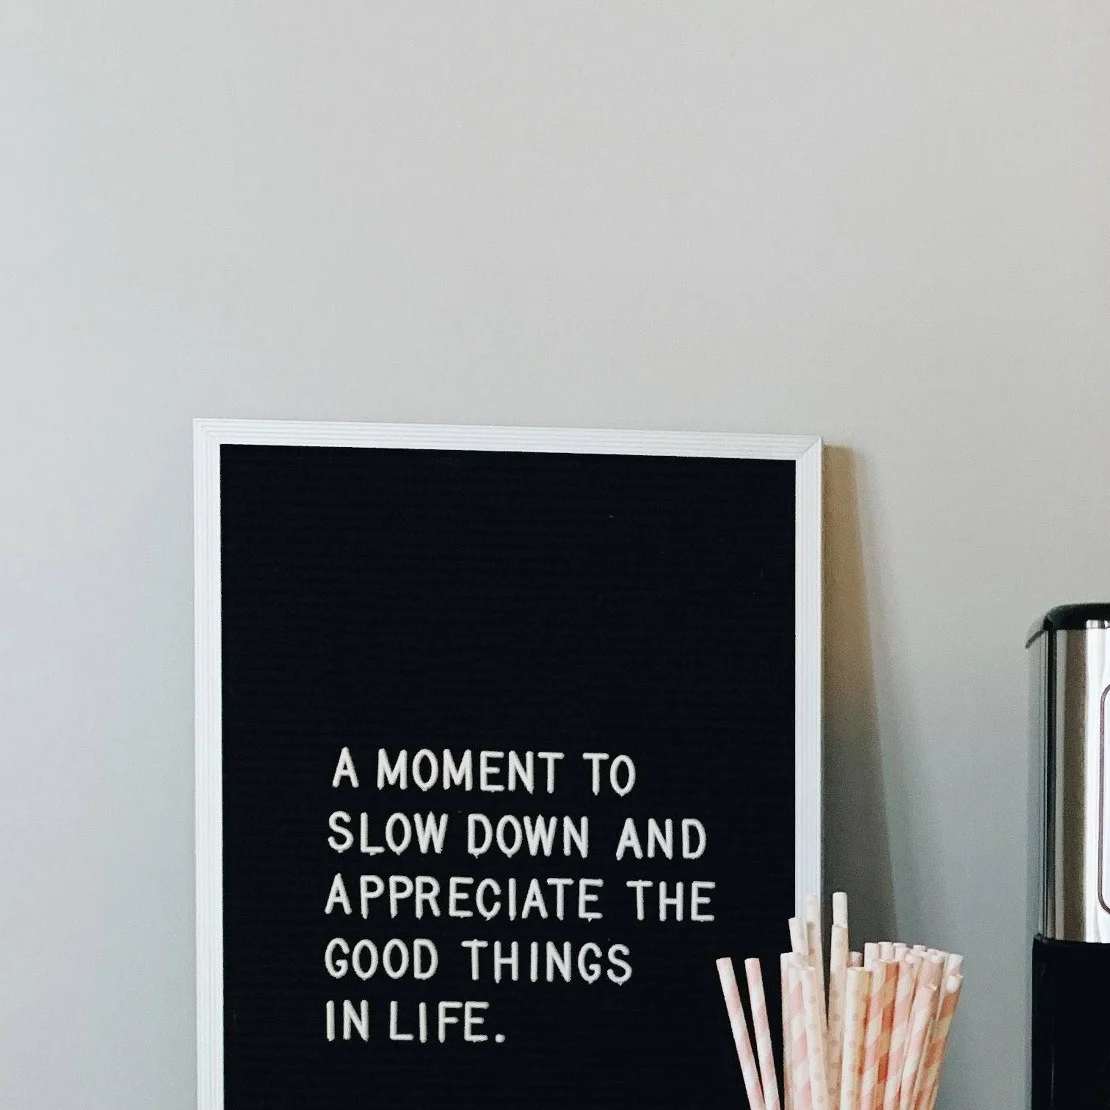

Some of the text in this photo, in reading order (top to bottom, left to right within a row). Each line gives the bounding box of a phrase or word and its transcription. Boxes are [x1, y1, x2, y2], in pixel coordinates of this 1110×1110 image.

[333, 747, 636, 797] A MOMENT TO
[328, 811, 707, 861] SLOW DOWN AND
[325, 873, 716, 923] APPRECIATE THE
[325, 938, 633, 986] GOOD THINGS
[326, 1000, 506, 1044] IN LIFE.
